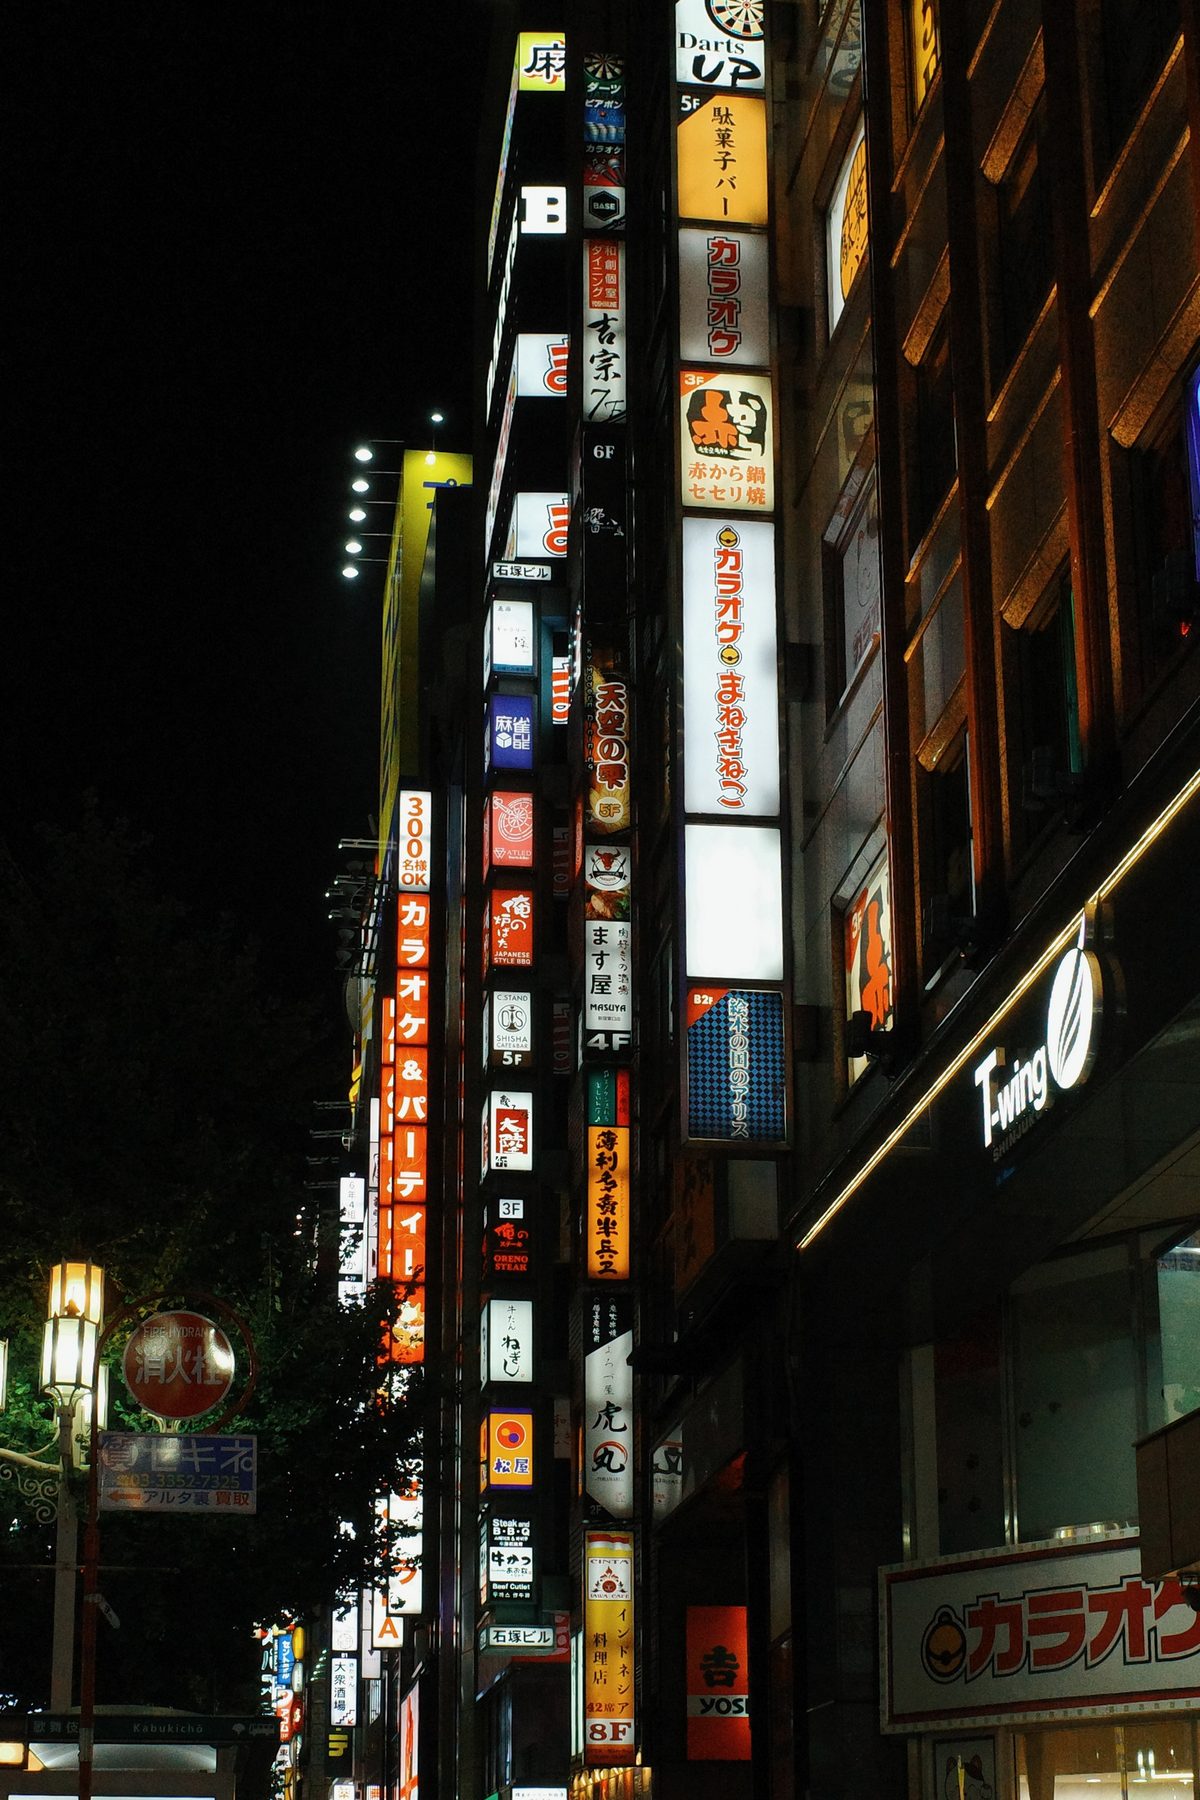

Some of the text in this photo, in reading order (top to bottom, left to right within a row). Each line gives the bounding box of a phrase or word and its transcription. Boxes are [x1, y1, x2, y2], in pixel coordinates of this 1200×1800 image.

[677, 32, 745, 55] Darts
[692, 55, 762, 87] UP
[586, 81, 622, 95] ダーツ
[681, 95, 701, 112] 5F
[711, 107, 737, 216] 駄菓子バー
[593, 202, 616, 211] BASE
[707, 236, 742, 357] カラオケ
[587, 313, 622, 381] 吉宗
[684, 375, 705, 386] 3F
[593, 445, 615, 459] 6F
[688, 462, 766, 484] 赤から鍋
[689, 483, 766, 506] セセリ焼
[495, 564, 548, 579] 石塚ビル
[715, 545, 744, 646] カラオケ
[496, 716, 531, 733] 麻雀
[714, 669, 749, 809] まねきねこ
[600, 802, 621, 817] 5F
[406, 797, 424, 858] 300
[402, 858, 427, 872] 名様
[401, 872, 427, 887] OK
[590, 926, 613, 995] ます屋
[590, 1003, 627, 1013] MASUYA
[693, 994, 714, 1005] B2F
[496, 1034, 528, 1043] SHISHA
[586, 1032, 632, 1051] 4F
[502, 1050, 523, 1066] 5F
[727, 997, 750, 1138] 絵本の国のアリス
[498, 1116, 527, 1156] 大陸
[502, 1202, 521, 1216] 3F
[493, 1222, 529, 1240] 俺の
[493, 1254, 529, 1264] ORENO
[495, 1263, 528, 1272] STEAK
[507, 1304, 517, 1332] 牛たん
[144, 1326, 214, 1338] FIRE HYDRAN
[500, 1334, 522, 1378] ねぎし
[493, 1457, 530, 1475] 松屋
[143, 1491, 250, 1506] アルタ裏 買取
[492, 1518, 518, 1528] Steak
[491, 1550, 532, 1567] 牛かつ
[492, 1583, 531, 1591] Beef Cutlet
[492, 1629, 550, 1645] 石塚ビル
[964, 1574, 1200, 1684] カラオケ
[592, 1631, 608, 1686] 料理店
[616, 1607, 631, 1715] インドネシア
[335, 1661, 346, 1712] 大衆酒場
[33, 1720, 80, 1734] 歌舞伎
[588, 1720, 632, 1742] 8F
